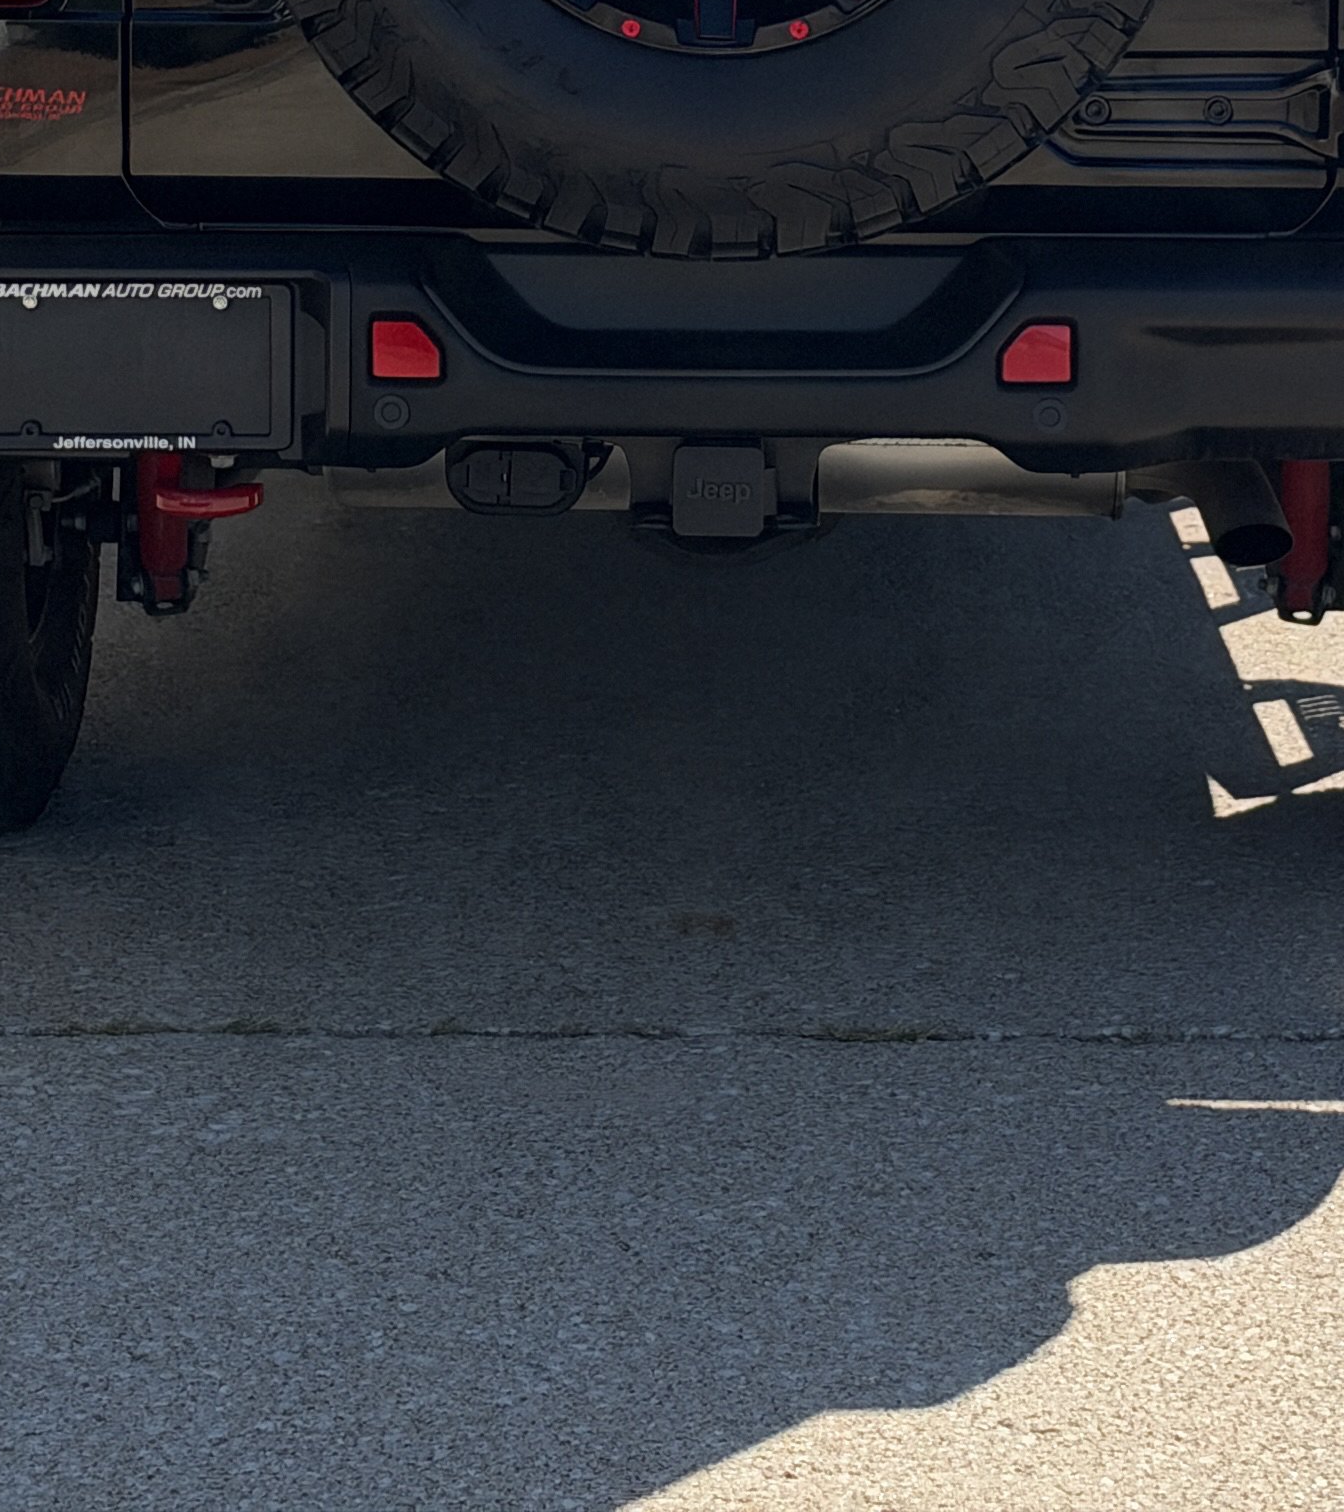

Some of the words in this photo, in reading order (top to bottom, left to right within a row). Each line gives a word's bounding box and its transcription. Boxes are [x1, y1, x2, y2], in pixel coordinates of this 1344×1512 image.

[102, 283, 153, 298] AUTO
[53, 436, 174, 451] Jeffersonville,
[178, 437, 196, 449] IN
[687, 478, 751, 503] Jeep
